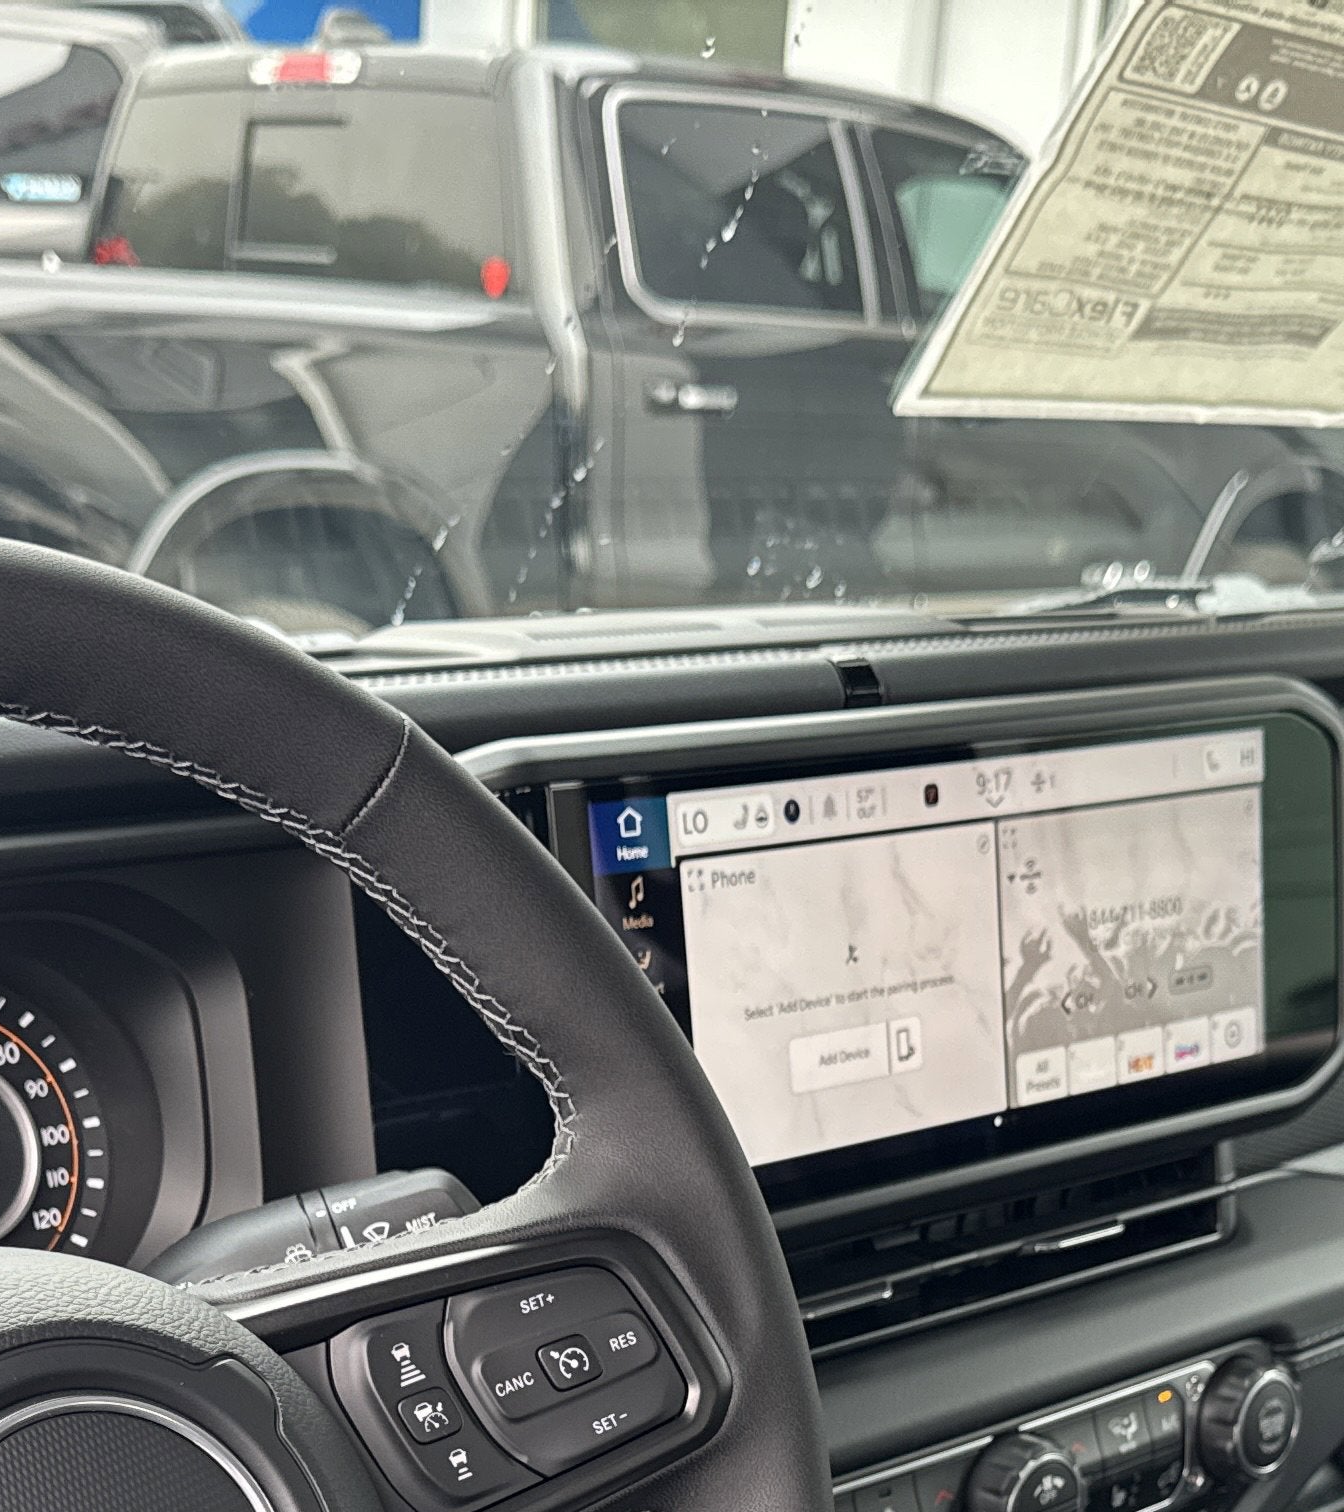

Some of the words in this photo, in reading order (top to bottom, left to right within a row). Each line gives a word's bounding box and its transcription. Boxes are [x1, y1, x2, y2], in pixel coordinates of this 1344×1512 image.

[682, 810, 709, 835] LO
[616, 846, 649, 861] Home
[711, 870, 757, 890] Phone
[622, 915, 654, 931] Media
[744, 1005, 774, 1021] Select
[819, 1051, 838, 1068] Add
[839, 1047, 871, 1065] Device
[24, 1078, 49, 1100] 90
[40, 1123, 70, 1147] 100
[45, 1167, 70, 1189] 110
[331, 1198, 357, 1215] OFF
[32, 1206, 62, 1231] 120
[405, 1212, 438, 1233] MIST
[519, 1293, 555, 1314] SET+
[609, 1331, 637, 1352] RES
[495, 1371, 535, 1398] CANC
